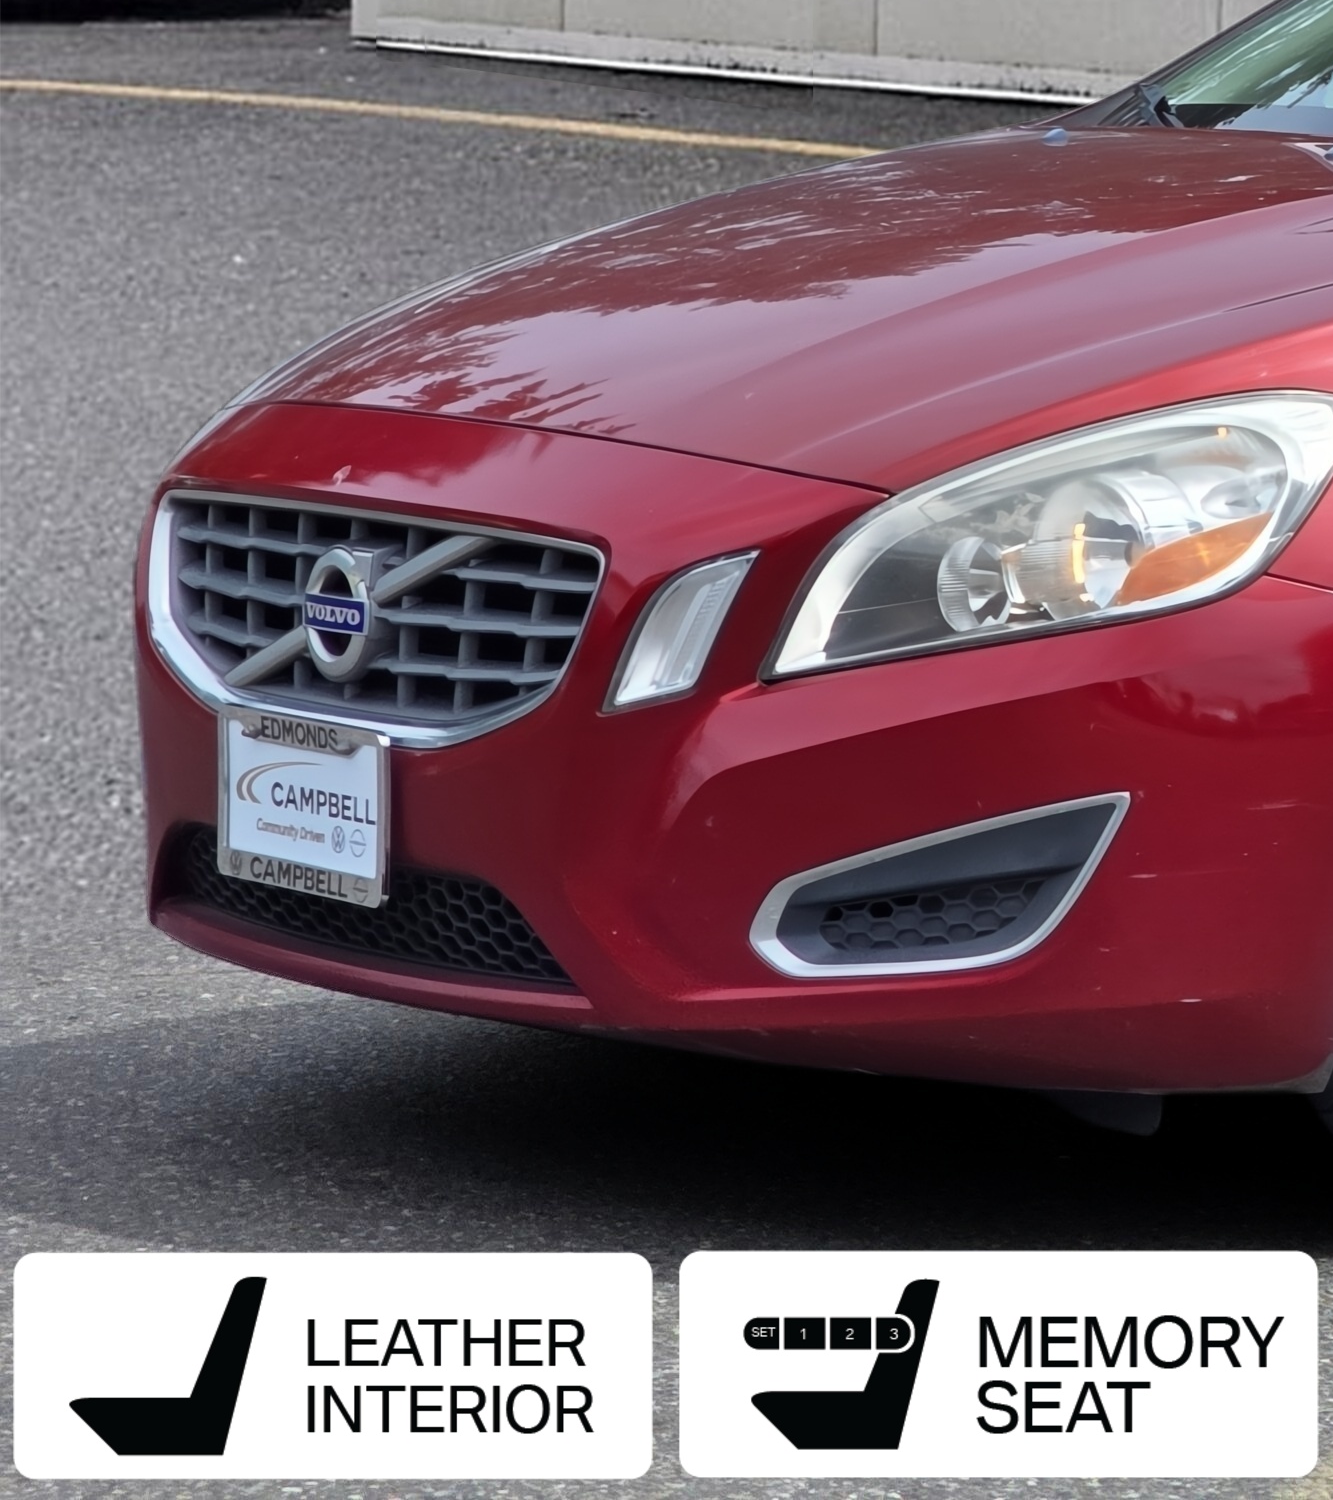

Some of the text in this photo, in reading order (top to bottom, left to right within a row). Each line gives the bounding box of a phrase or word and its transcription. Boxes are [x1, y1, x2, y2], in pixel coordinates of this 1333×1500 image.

[305, 601, 361, 626] VOLVO
[260, 715, 339, 750] EDMONDS
[270, 781, 376, 826] CAMPBELL
[256, 817, 326, 844] Community Driven
[249, 856, 348, 899] CAMPBELL
